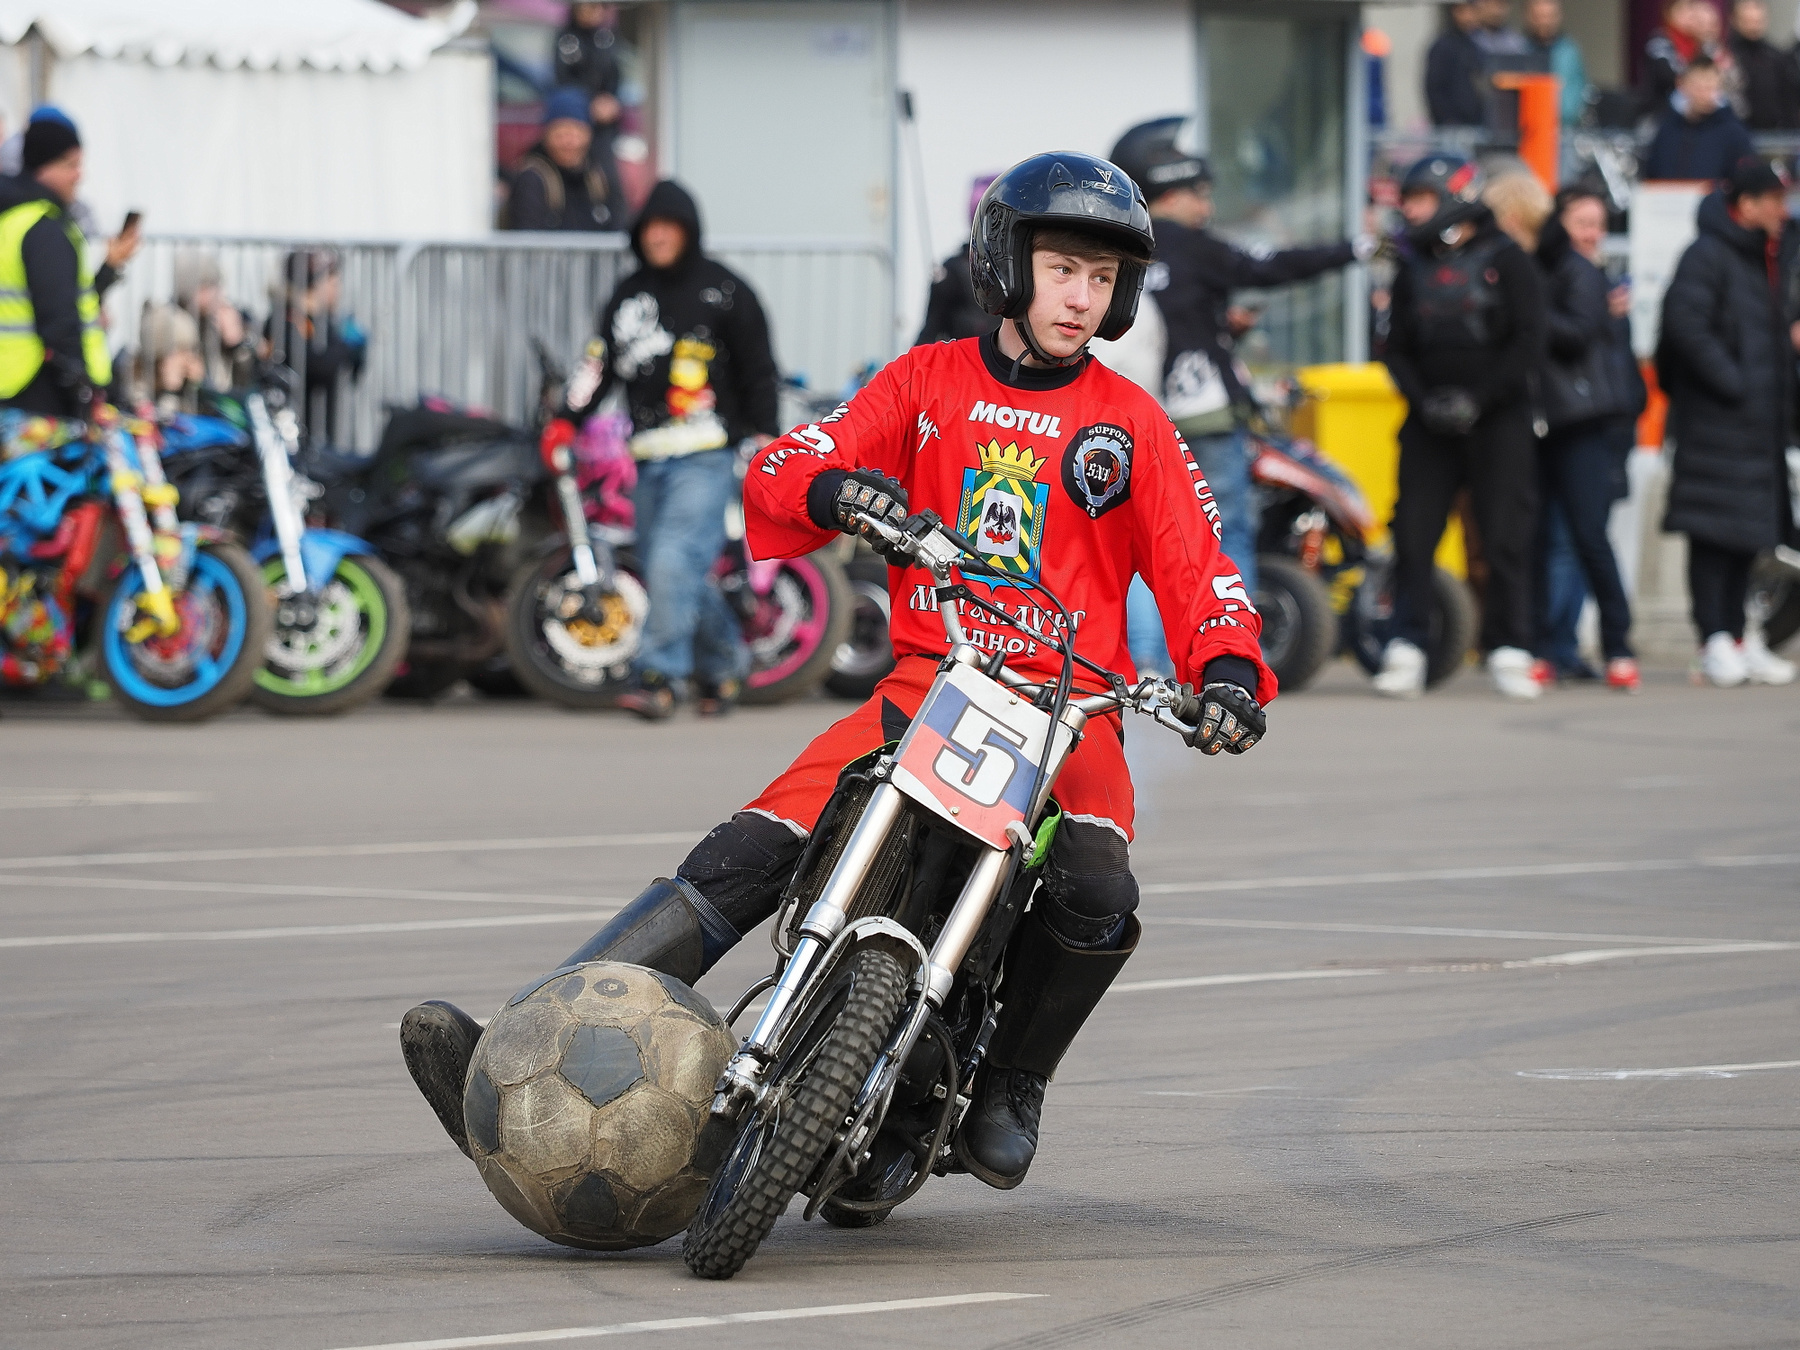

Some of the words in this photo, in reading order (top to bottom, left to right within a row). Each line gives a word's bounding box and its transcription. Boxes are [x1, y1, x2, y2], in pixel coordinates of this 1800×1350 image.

[968, 400, 1062, 438] MOTUL
[1088, 426, 1132, 450] SUPPORT
[945, 626, 1037, 658] ИДНОЕ
[932, 700, 1028, 808] 5
